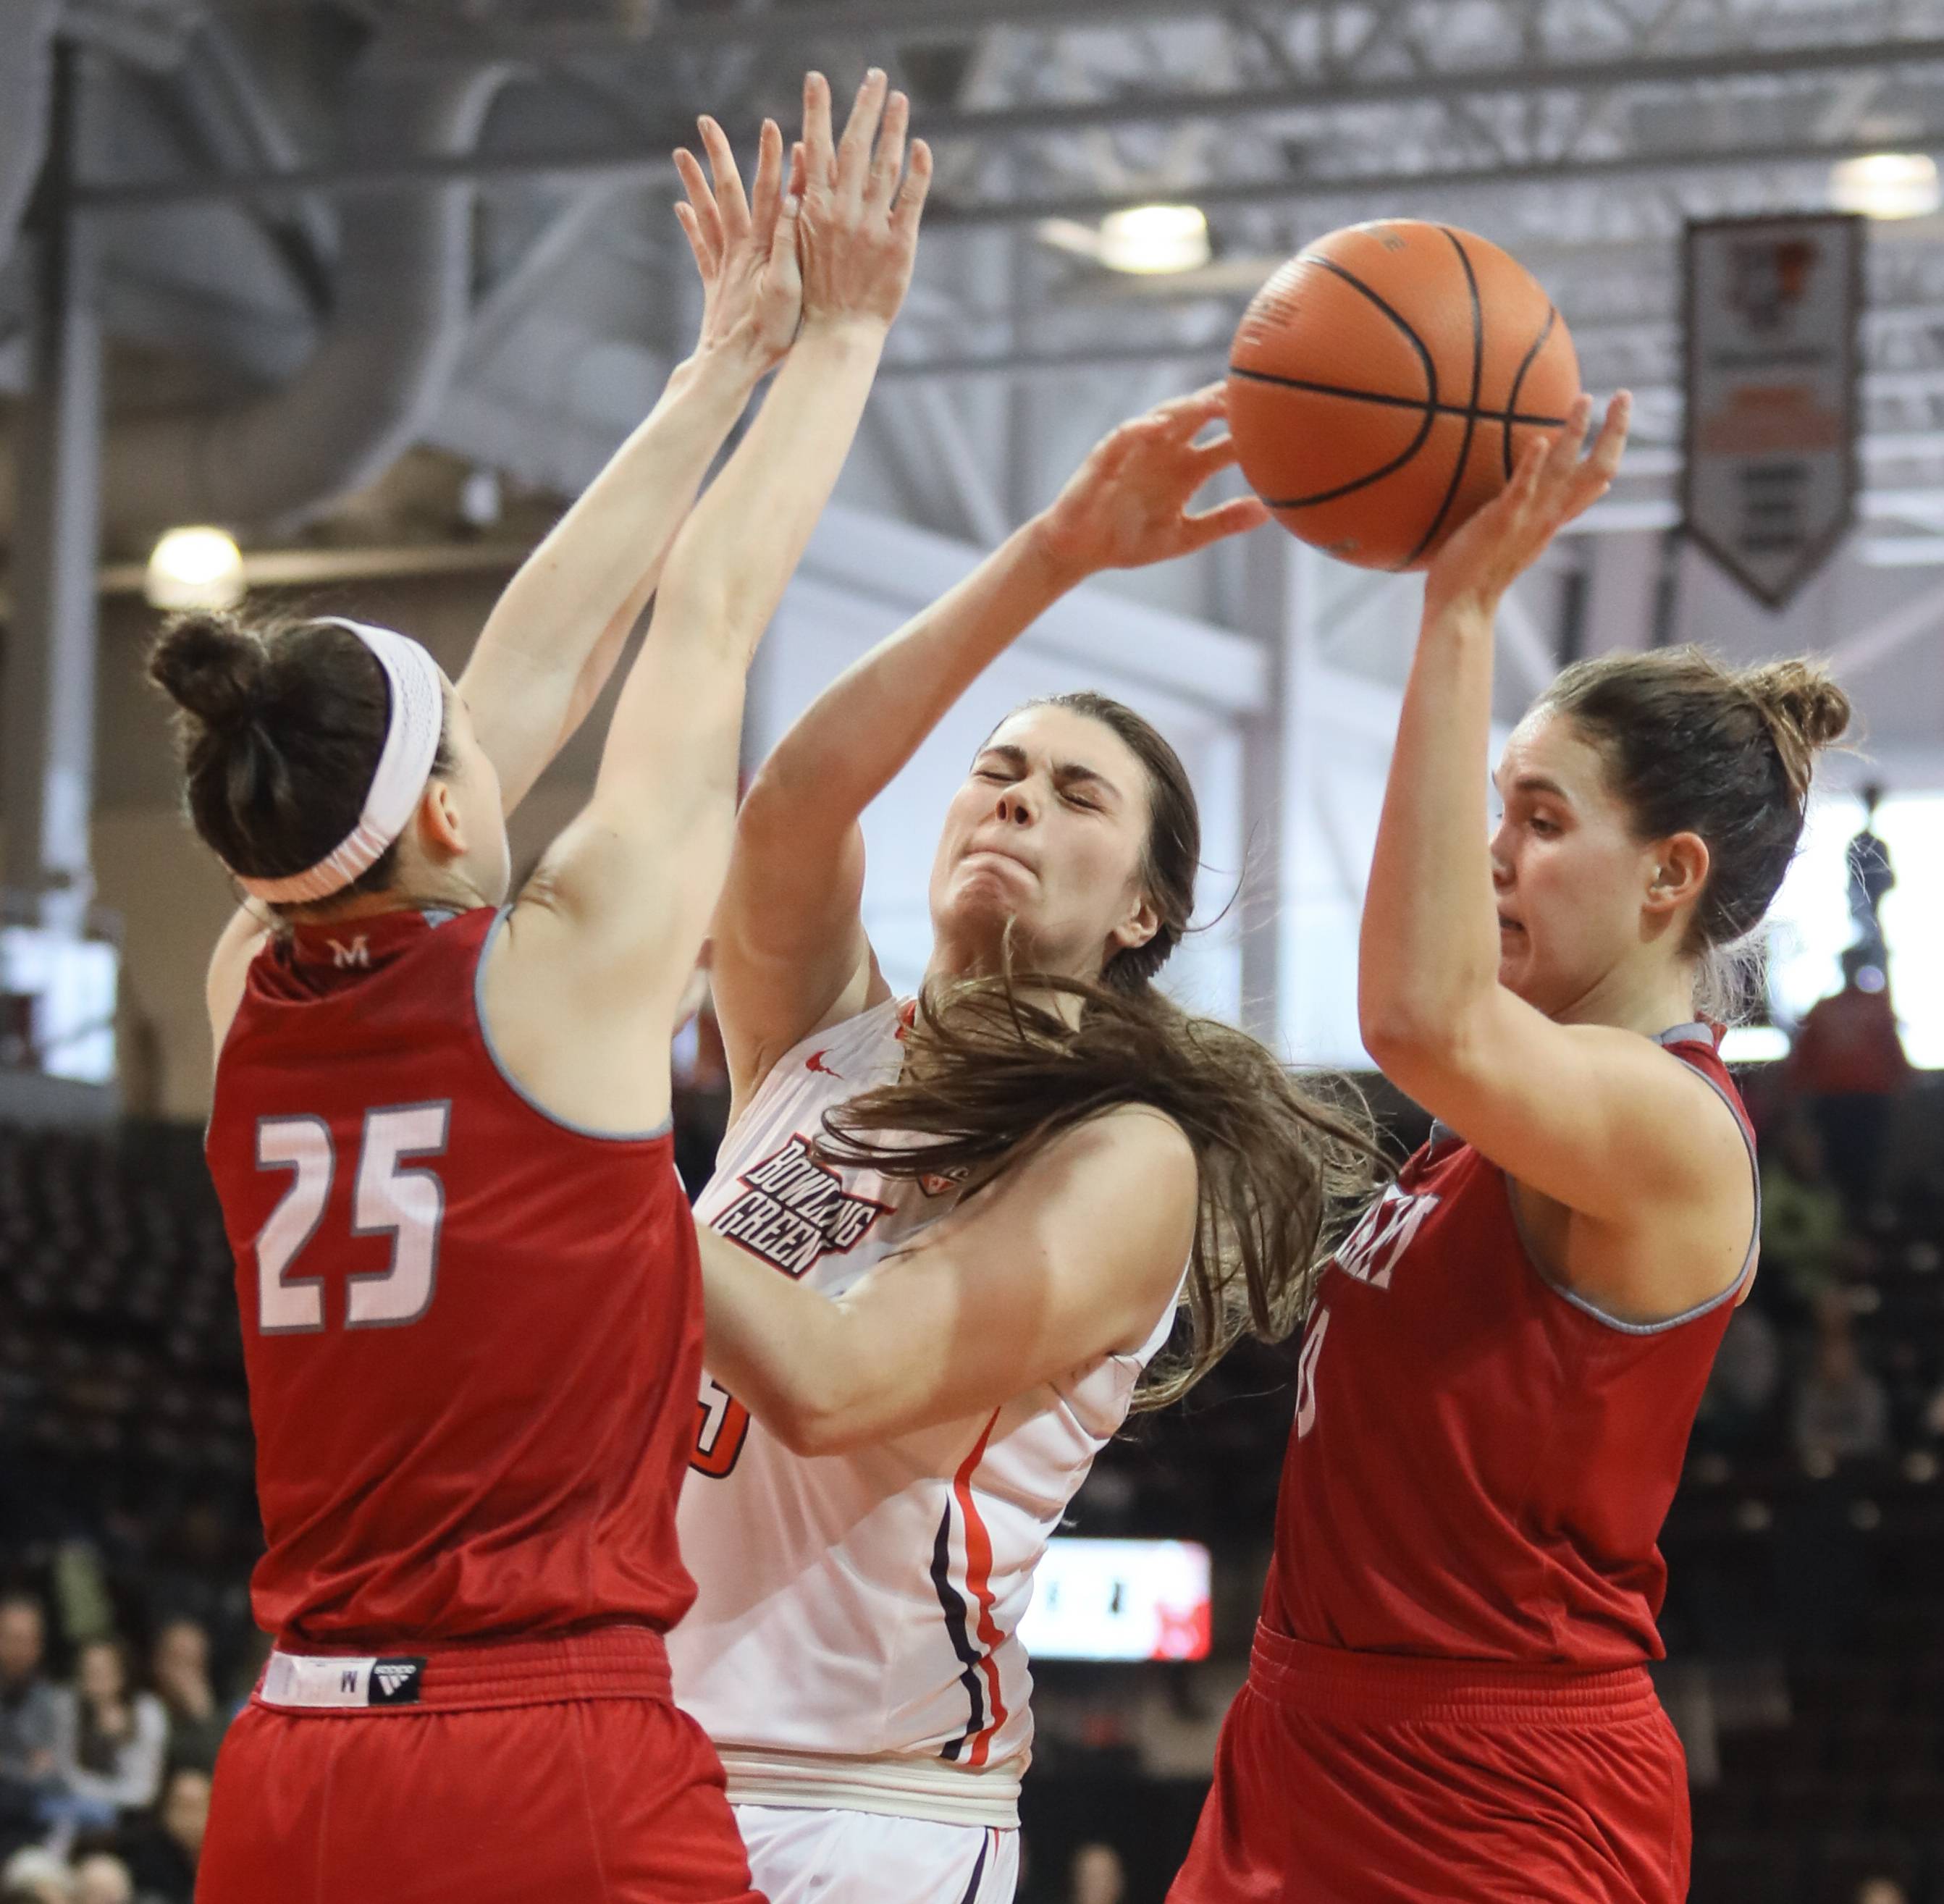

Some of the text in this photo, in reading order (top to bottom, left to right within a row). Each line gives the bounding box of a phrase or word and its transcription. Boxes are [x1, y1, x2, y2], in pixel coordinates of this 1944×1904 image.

[326, 935, 371, 968] M
[256, 1100, 451, 1334] 25
[712, 1190, 821, 1274] GREEN
[745, 1140, 877, 1247] BOWLING
